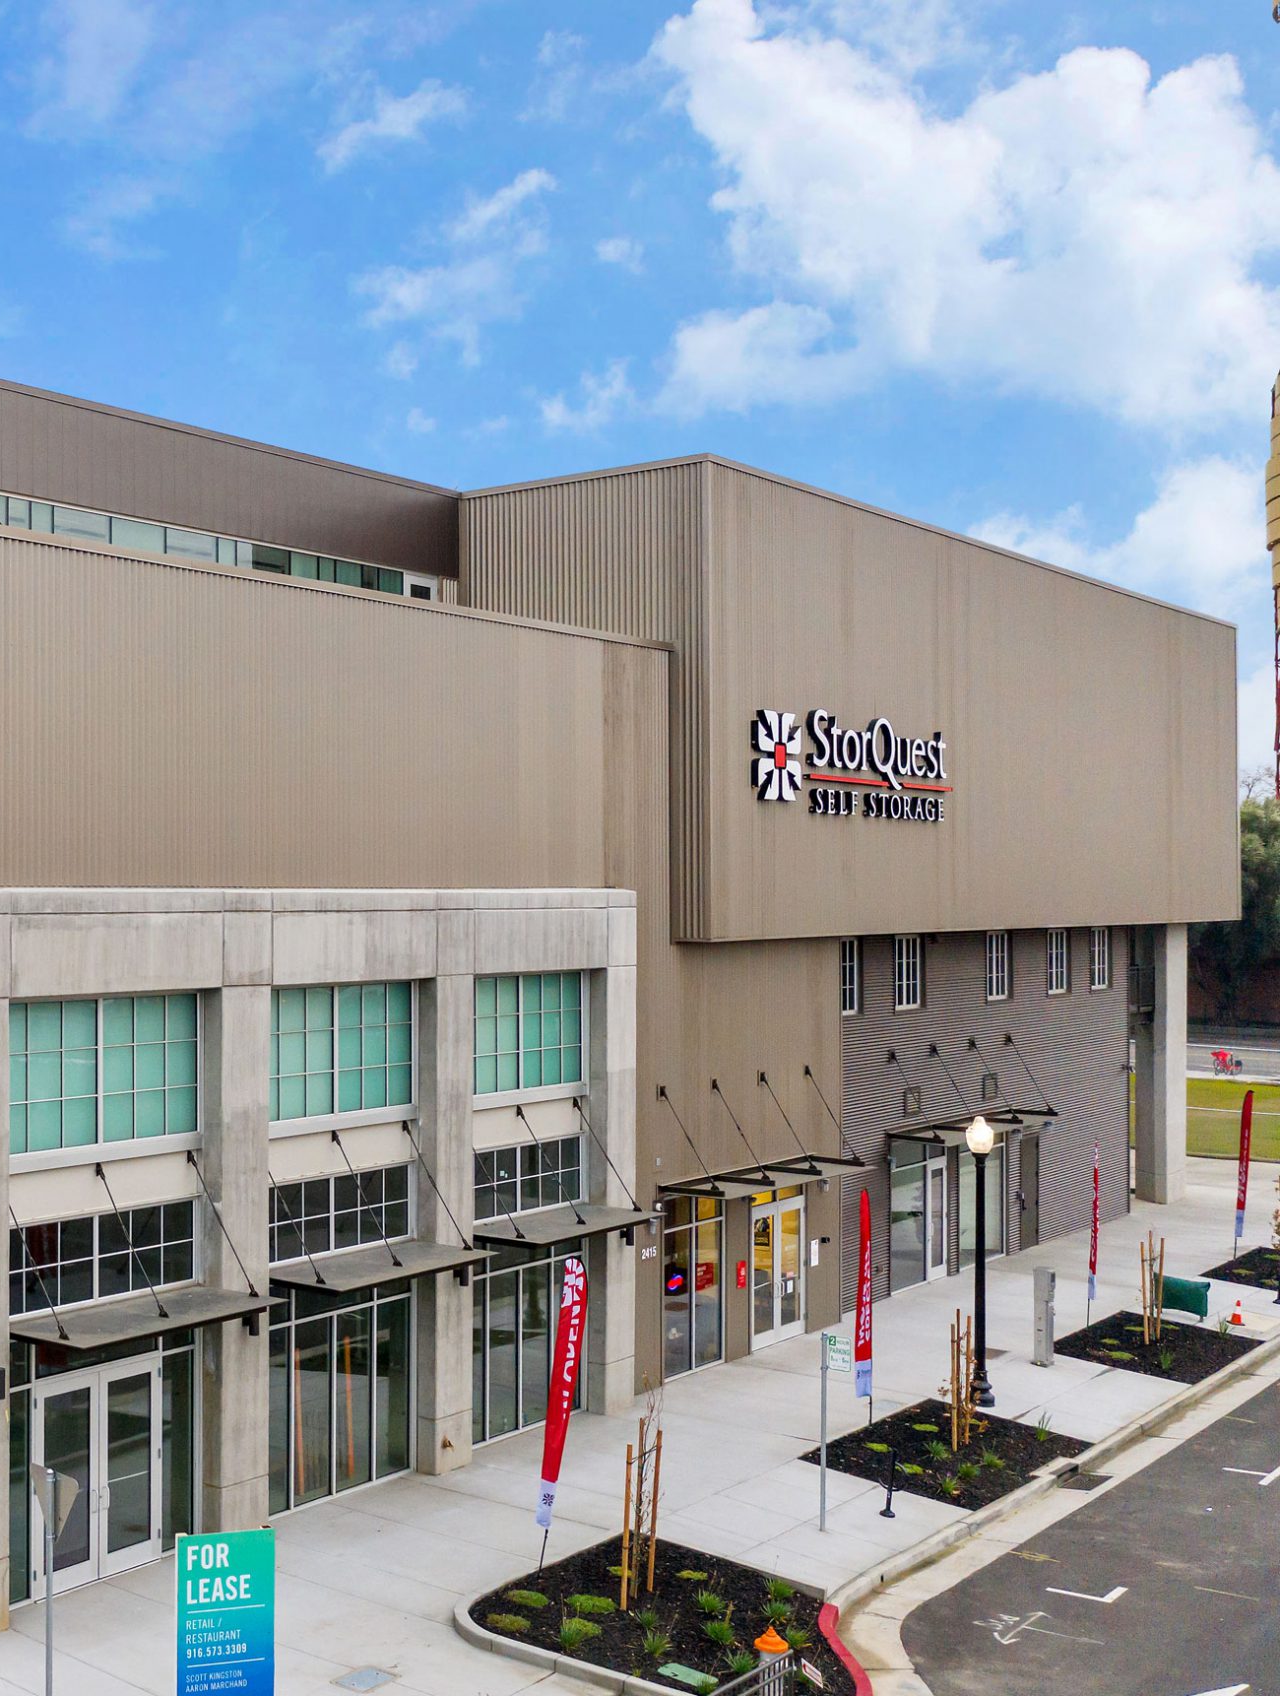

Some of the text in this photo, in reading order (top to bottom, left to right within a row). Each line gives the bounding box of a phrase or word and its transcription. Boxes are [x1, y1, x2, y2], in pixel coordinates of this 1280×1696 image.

[810, 708, 947, 790] StorQuest
[814, 787, 945, 822] SELF STORAGE
[641, 1246, 657, 1260] 2415
[829, 1336, 836, 1346] 2
[186, 1543, 230, 1571] FOR
[186, 1574, 251, 1605] LEASE
[186, 1618, 215, 1630] RETAIL
[186, 1629, 241, 1645] RESTAURANT
[186, 1642, 247, 1659] 916.573.3309
[186, 1669, 242, 1683] SCOTT KINGSTON
[186, 1679, 248, 1693] AARON MARCHAND
